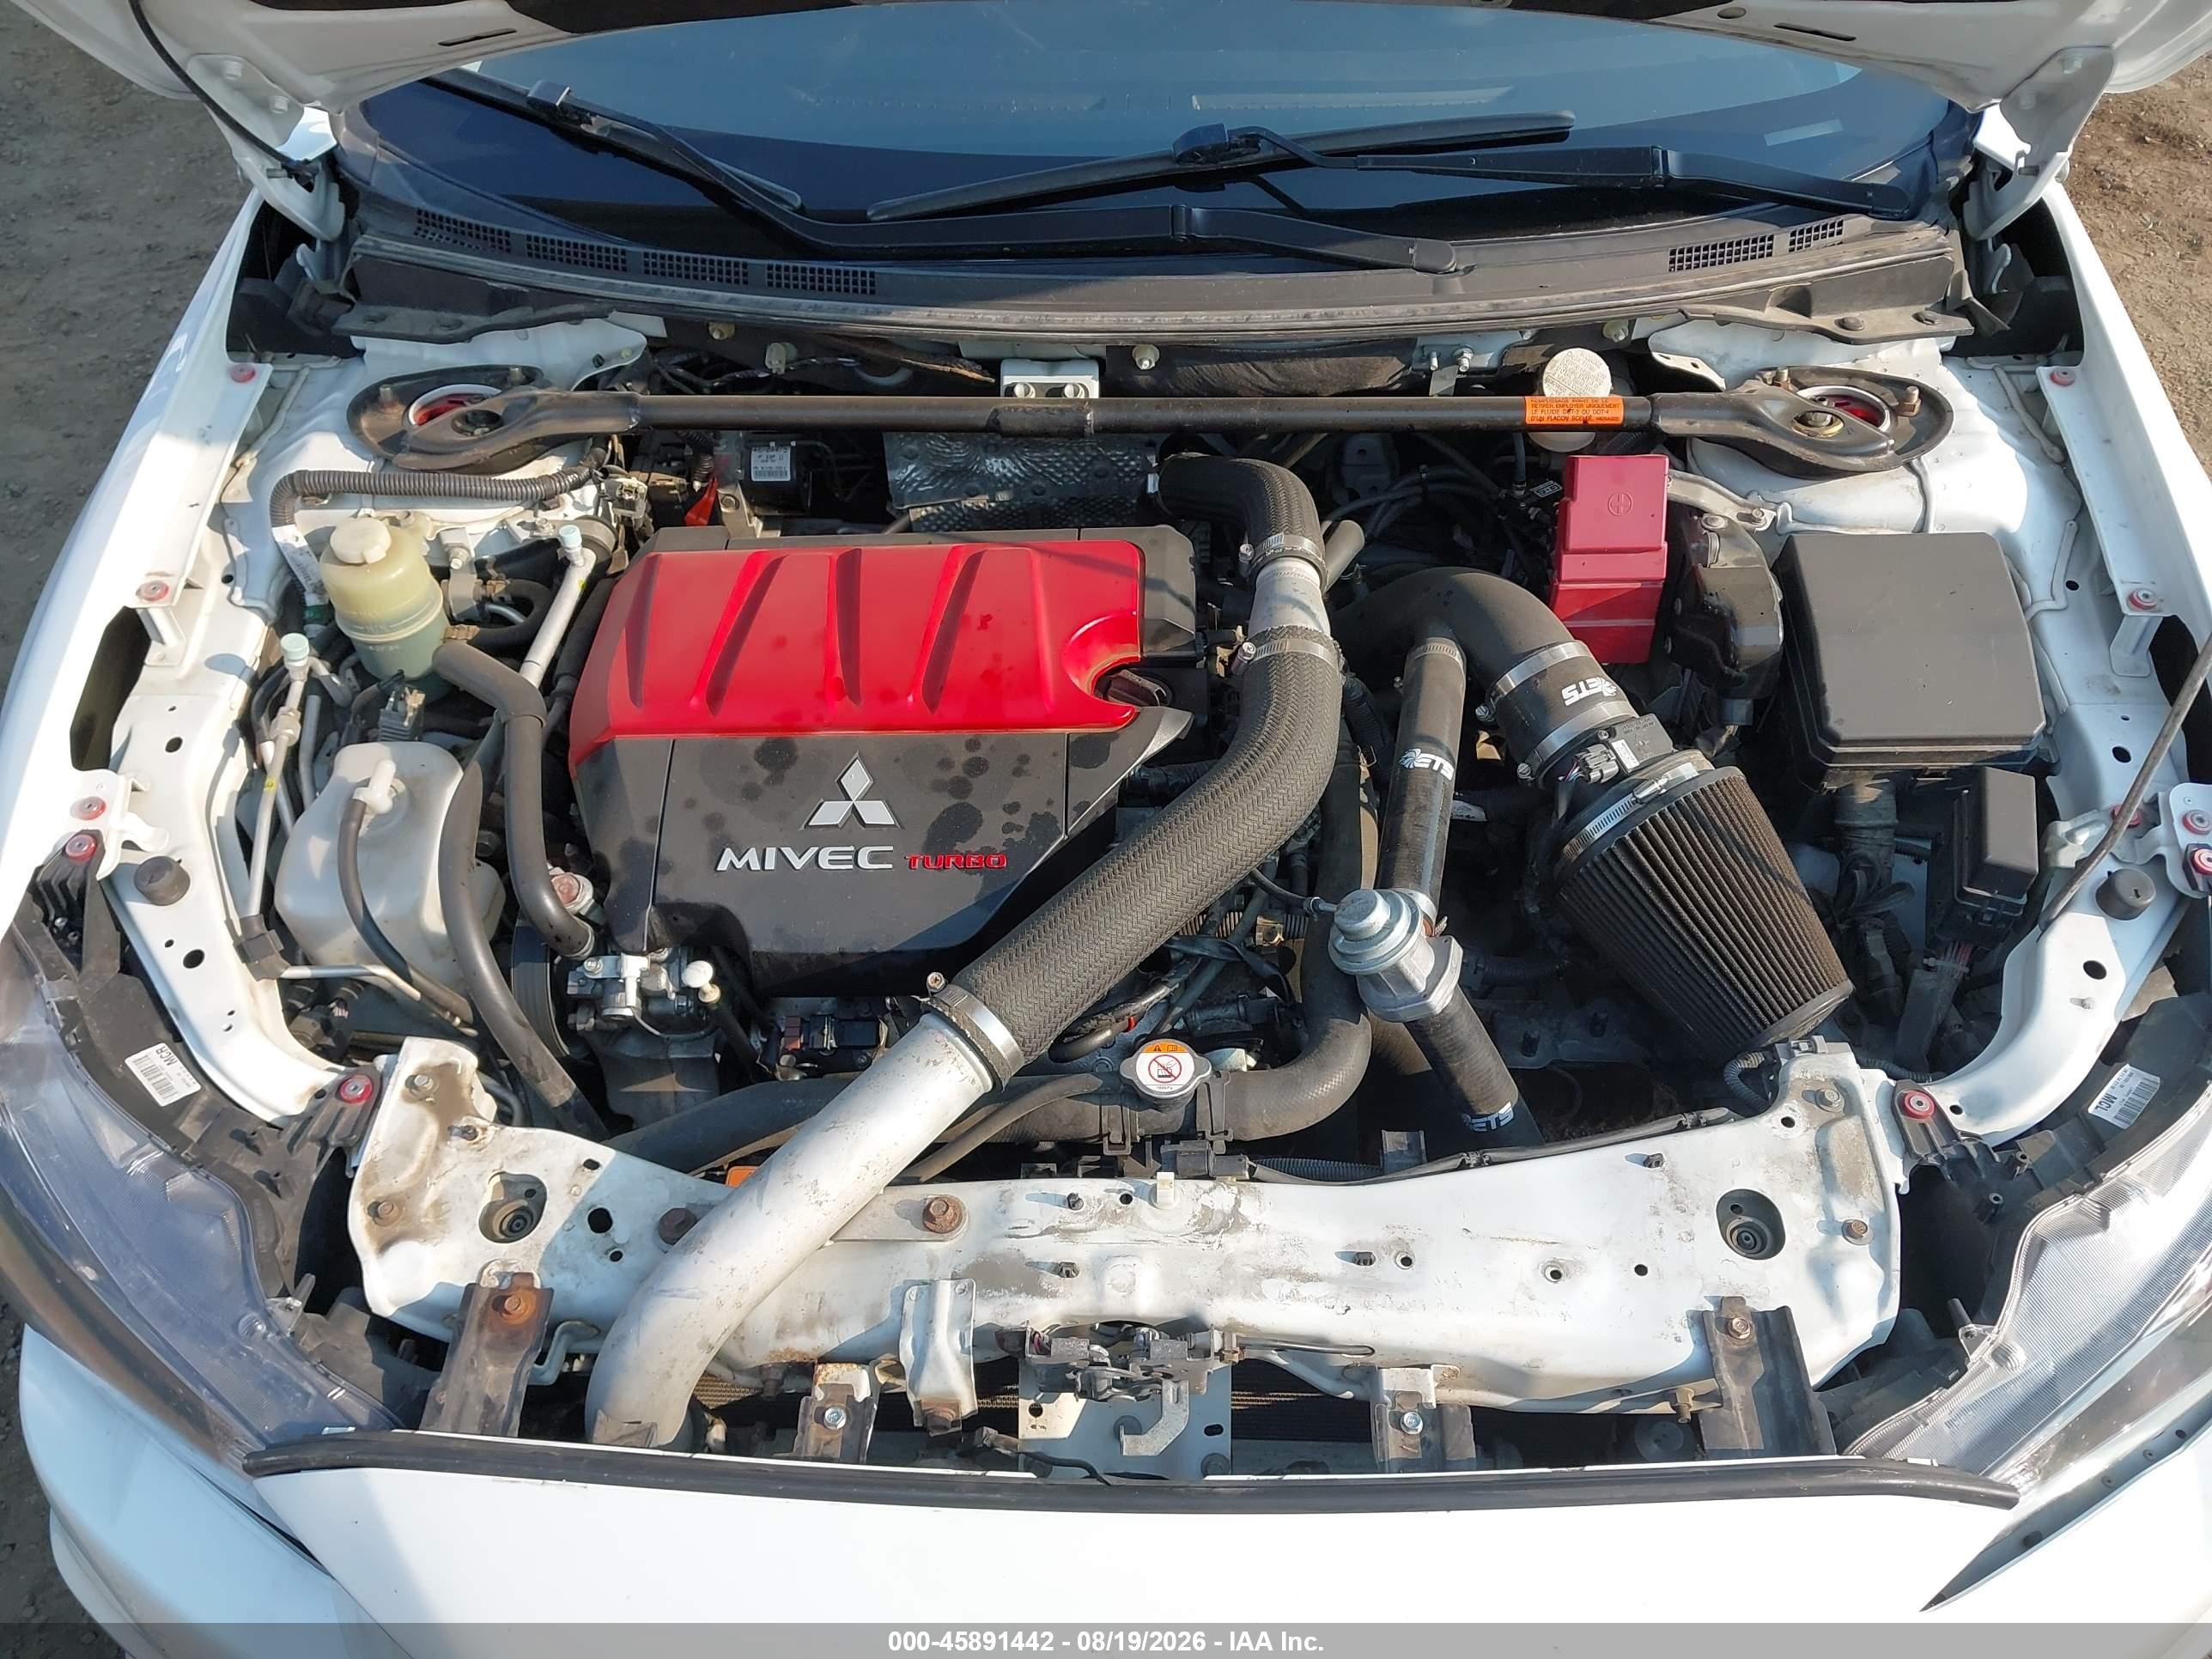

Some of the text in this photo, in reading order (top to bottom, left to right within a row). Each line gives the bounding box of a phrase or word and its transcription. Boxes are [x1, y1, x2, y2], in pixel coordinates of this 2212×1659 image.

[1561, 677, 1602, 706] ETS
[1415, 753, 1455, 781] ETS
[715, 845, 1009, 872] MIVEC TURBO
[155, 1045, 179, 1066] MCR
[2094, 1092, 2118, 1112] MCL
[1470, 1102, 1514, 1132] ETS
